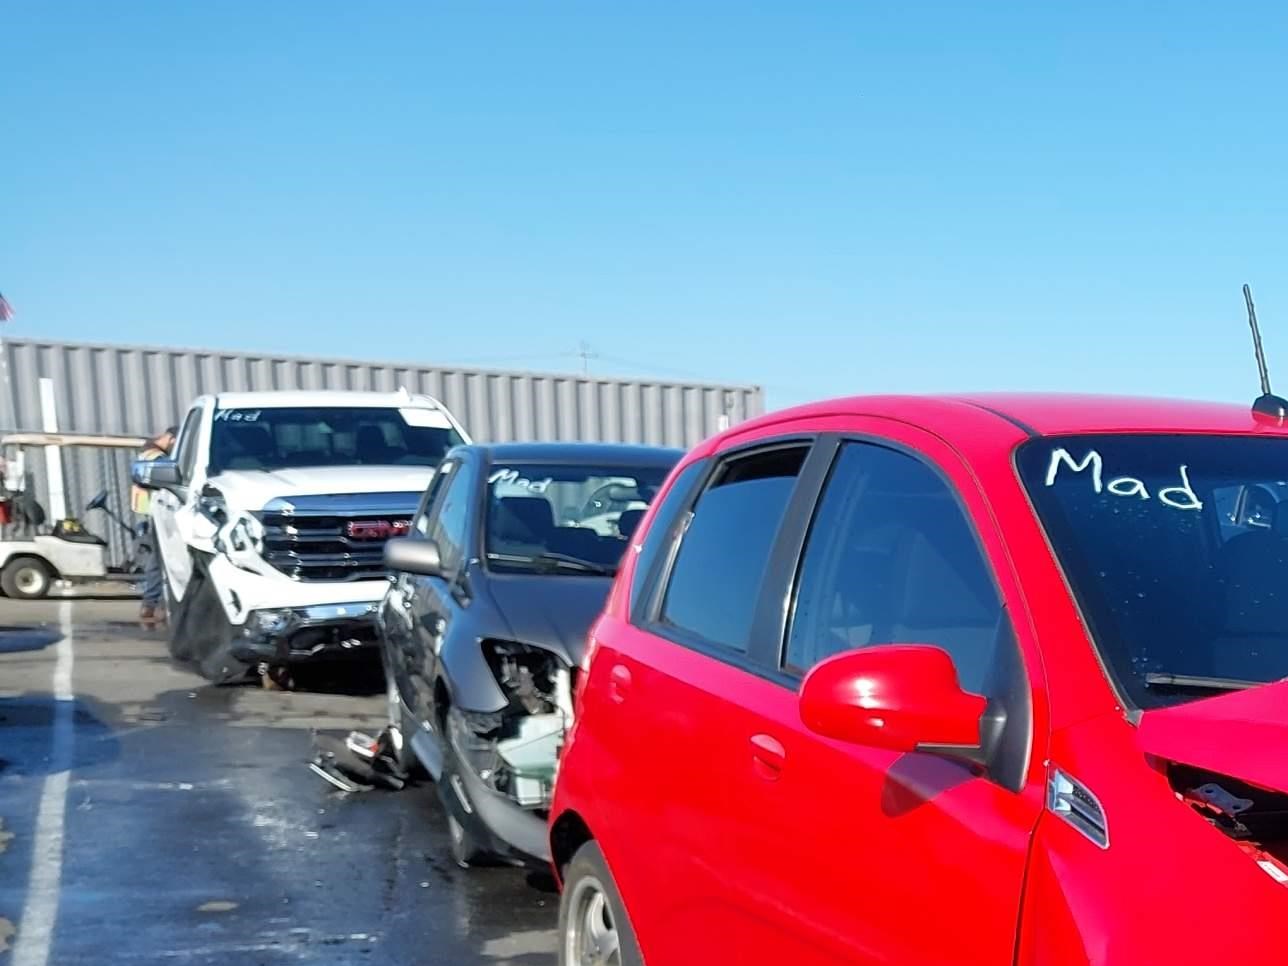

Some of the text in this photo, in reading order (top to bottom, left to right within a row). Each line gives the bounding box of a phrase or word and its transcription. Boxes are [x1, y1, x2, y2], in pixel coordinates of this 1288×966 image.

[214, 410, 262, 422] Mad
[488, 468, 553, 493] Mad
[1045, 449, 1203, 510] Mad
